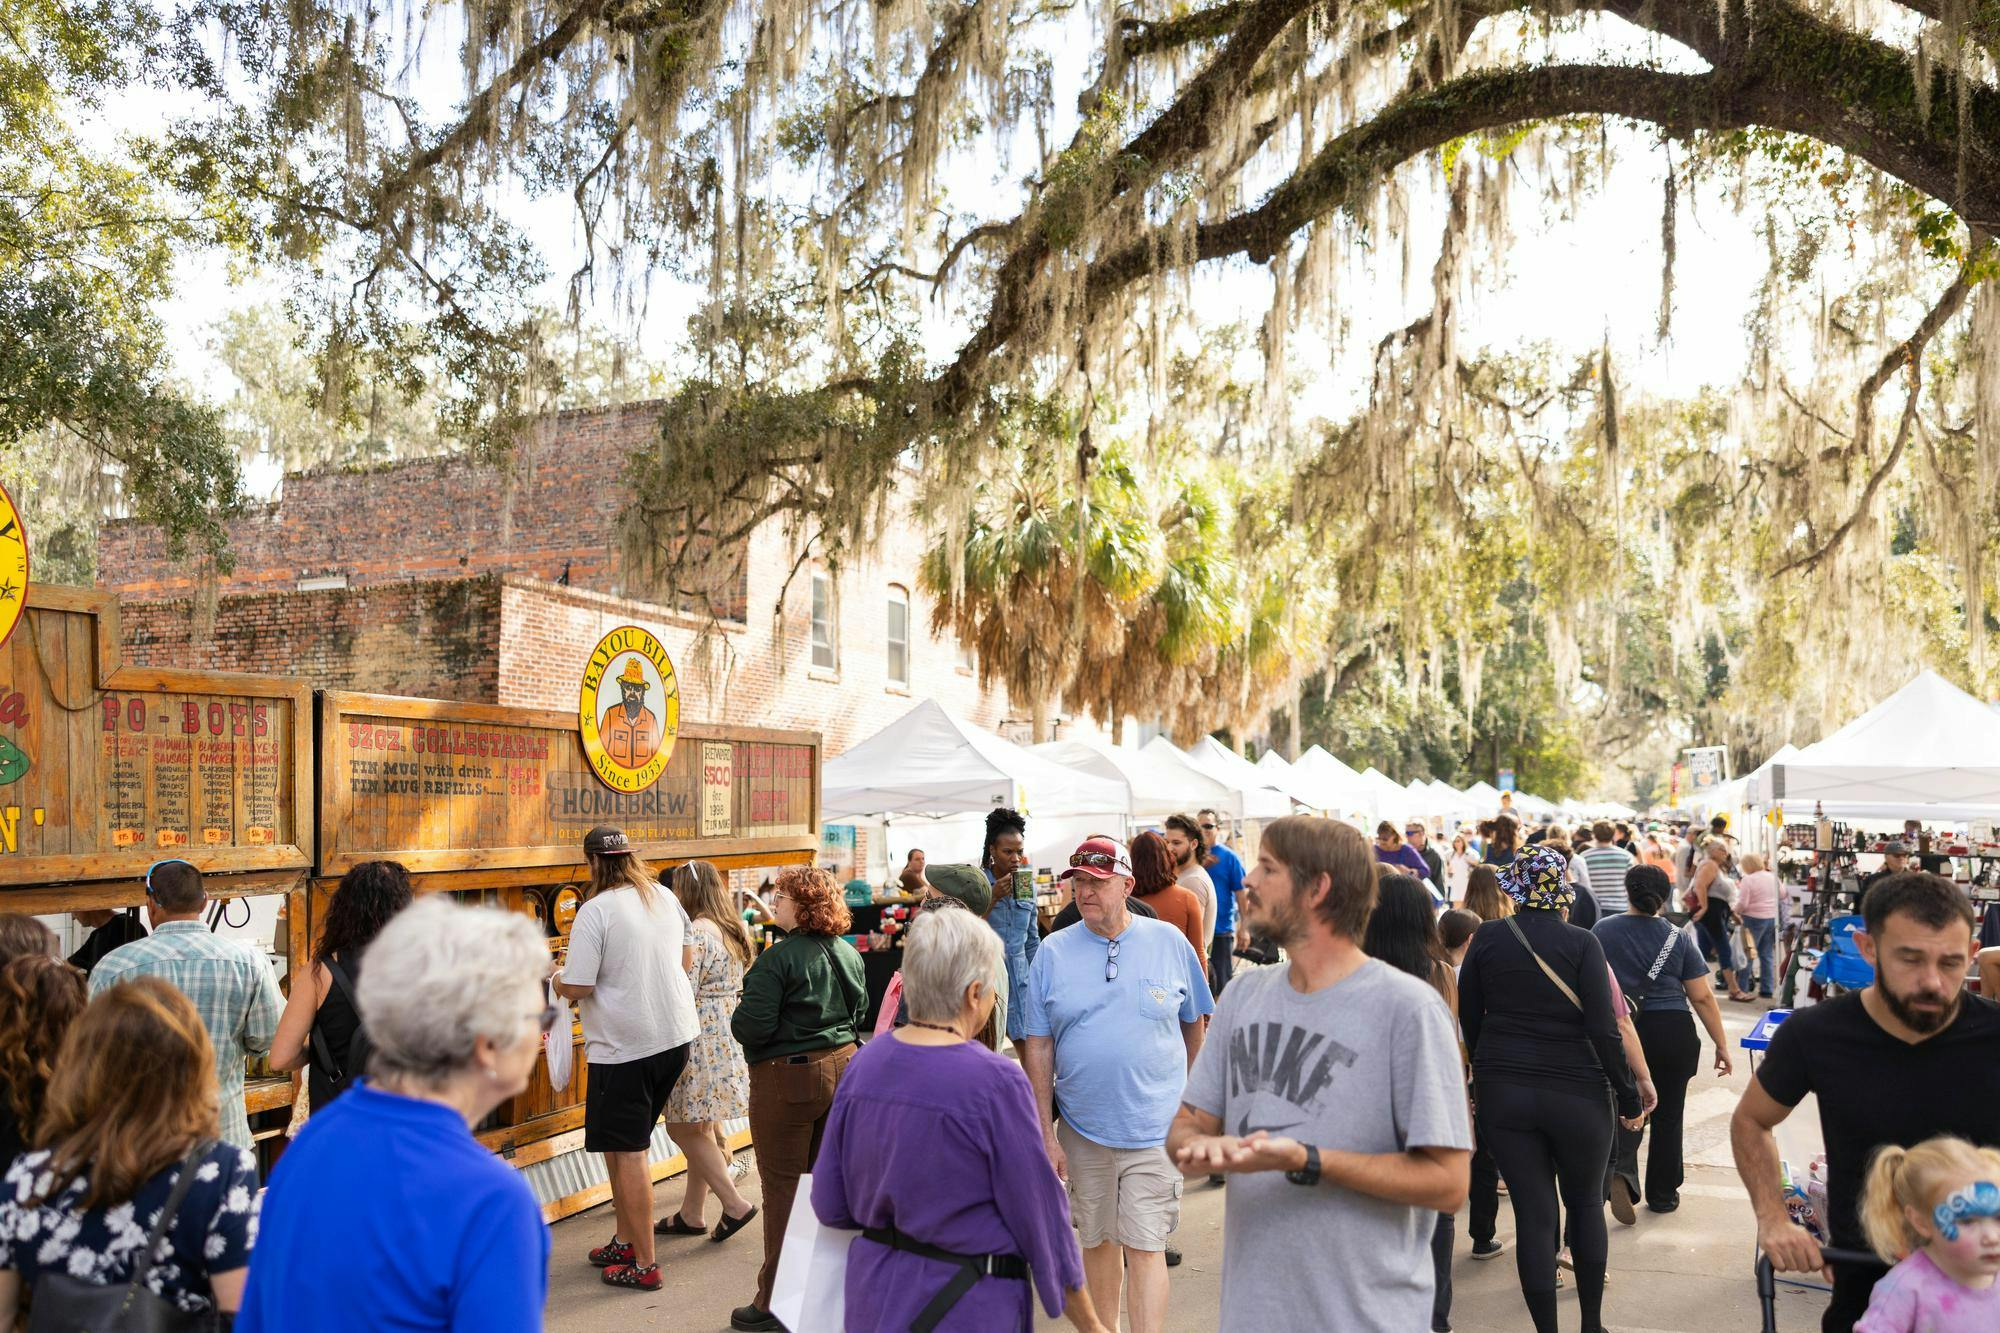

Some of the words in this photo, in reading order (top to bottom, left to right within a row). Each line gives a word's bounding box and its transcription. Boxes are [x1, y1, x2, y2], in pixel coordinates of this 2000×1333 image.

[585, 630, 635, 692] BAYOU
[642, 635, 677, 700] BILLY
[102, 697, 145, 732] PO
[181, 702, 268, 737] BOYS
[412, 726, 549, 760] COLLECTABLE
[154, 752, 193, 764] SAUSAGE
[199, 753, 237, 764] CHICKEN
[704, 747, 731, 761] REWARD
[114, 761, 133, 769] WITH
[350, 760, 378, 776] TIN
[383, 761, 418, 776] MUG
[424, 764, 455, 779] with
[458, 766, 492, 780] drink
[597, 754, 630, 788] Since
[635, 759, 661, 787] 1953
[113, 771, 140, 779] ONIONS
[704, 765, 731, 787] $500
[110, 781, 141, 789] PEPPERS
[350, 778, 378, 794] TIN
[383, 779, 420, 794] MUG
[562, 787, 688, 817] HOMEBREW
[712, 791, 722, 802] for
[112, 812, 138, 820] CHEESE
[109, 821, 121, 829] HOT
[704, 819, 717, 831] TIN
[558, 828, 580, 839] OLD
[647, 827, 695, 839] FLAVORS
[1229, 1021, 1359, 1117] NIKE
